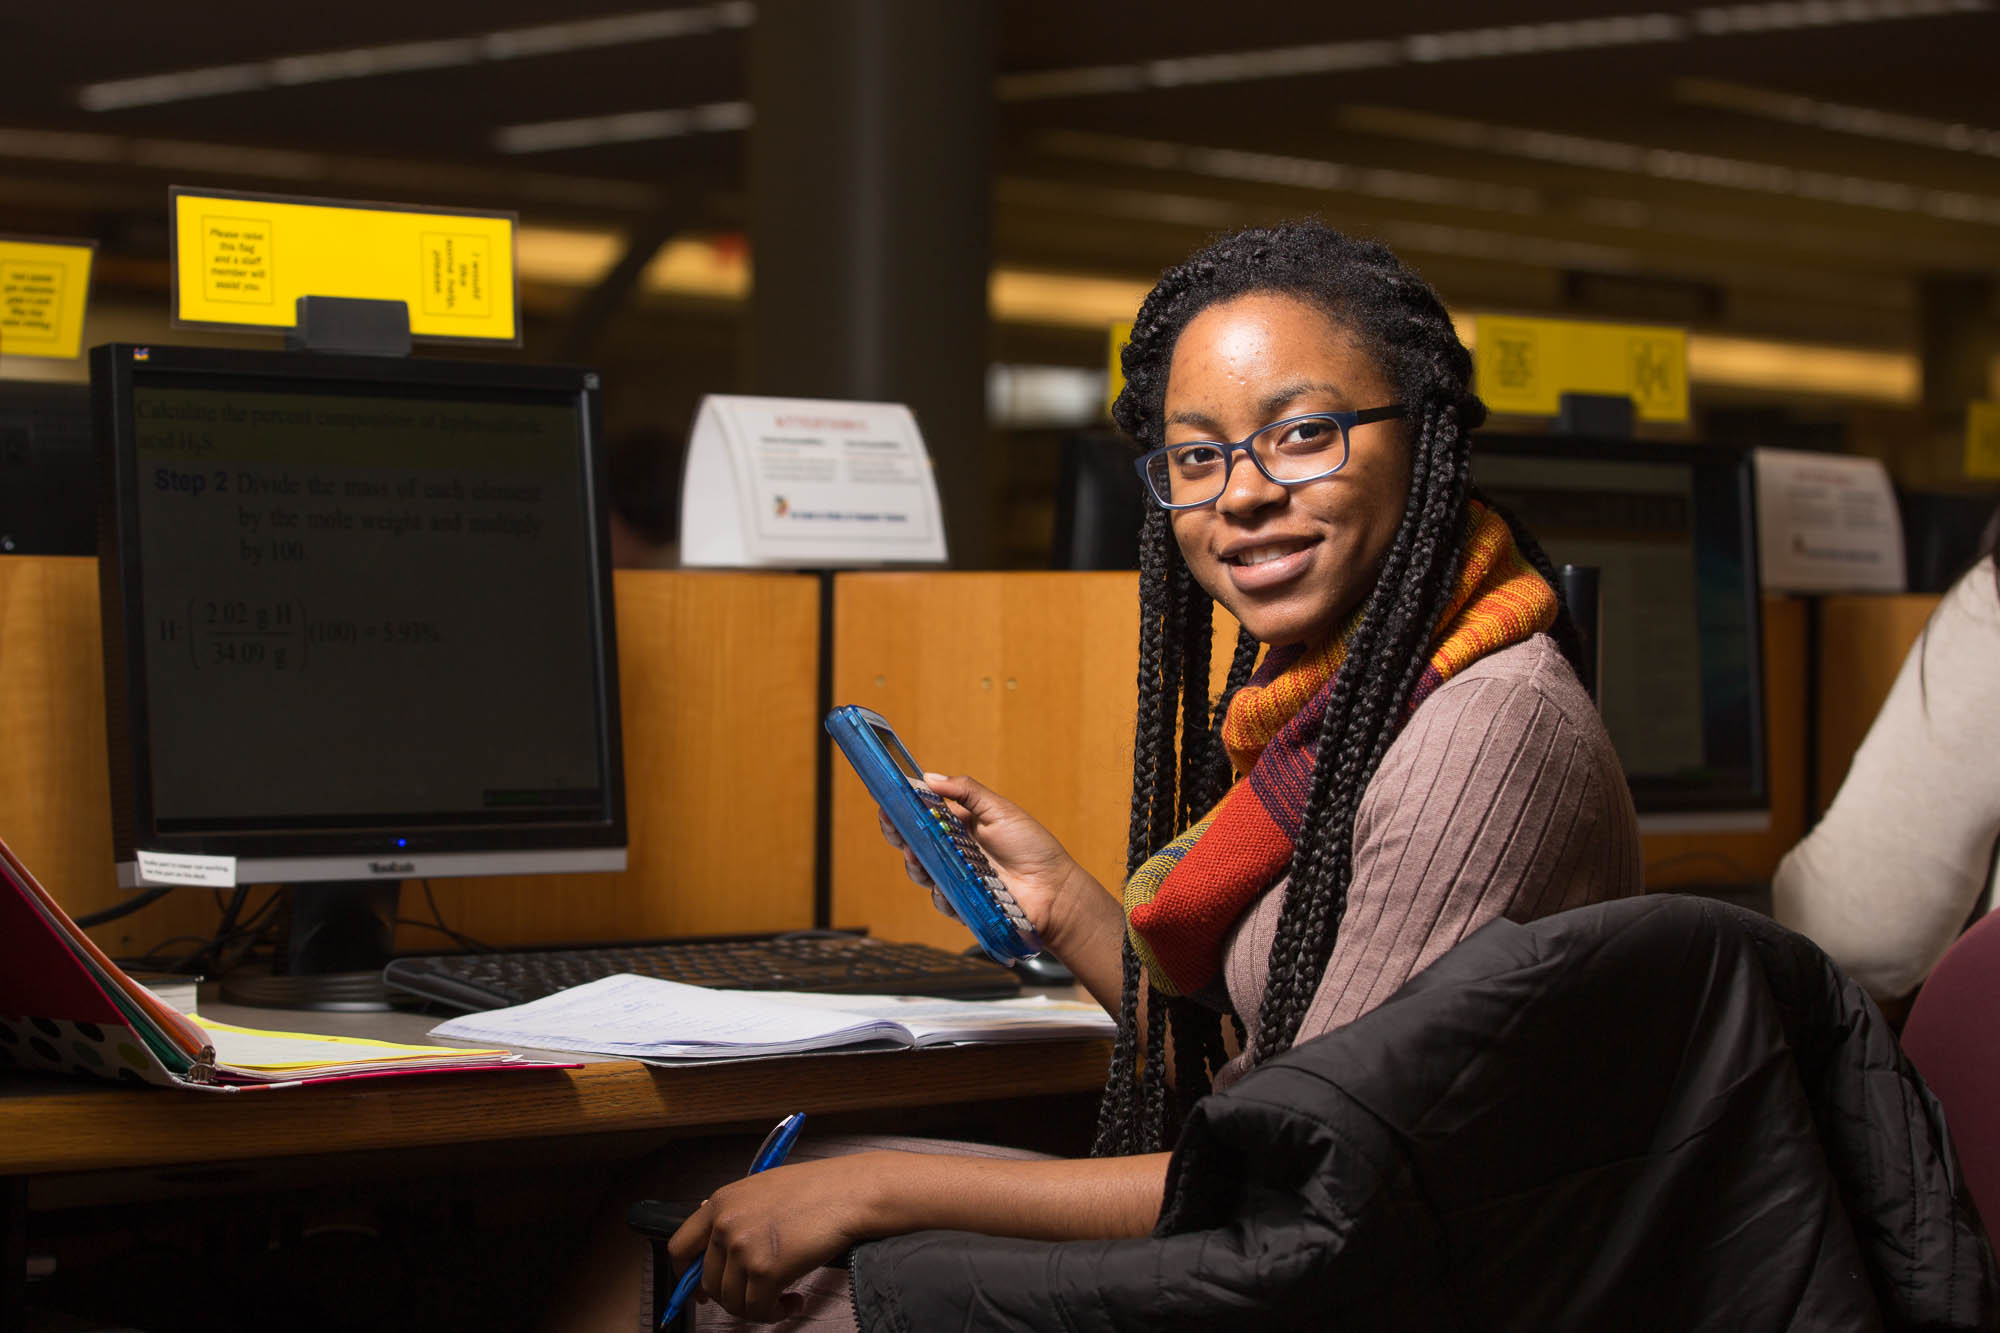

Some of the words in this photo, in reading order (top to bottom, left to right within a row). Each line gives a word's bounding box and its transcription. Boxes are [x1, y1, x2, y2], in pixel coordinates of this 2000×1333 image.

[221, 400, 247, 424] the
[152, 467, 206, 497] Step
[215, 470, 229, 493] 2
[236, 471, 299, 495] Divide
[306, 473, 335, 497] the
[343, 480, 388, 499] mass
[395, 476, 418, 500] of
[237, 505, 261, 535] by
[268, 506, 299, 529] the
[307, 507, 353, 531] mole
[360, 508, 421, 537] weight
[429, 510, 462, 533] and
[239, 538, 264, 567] by
